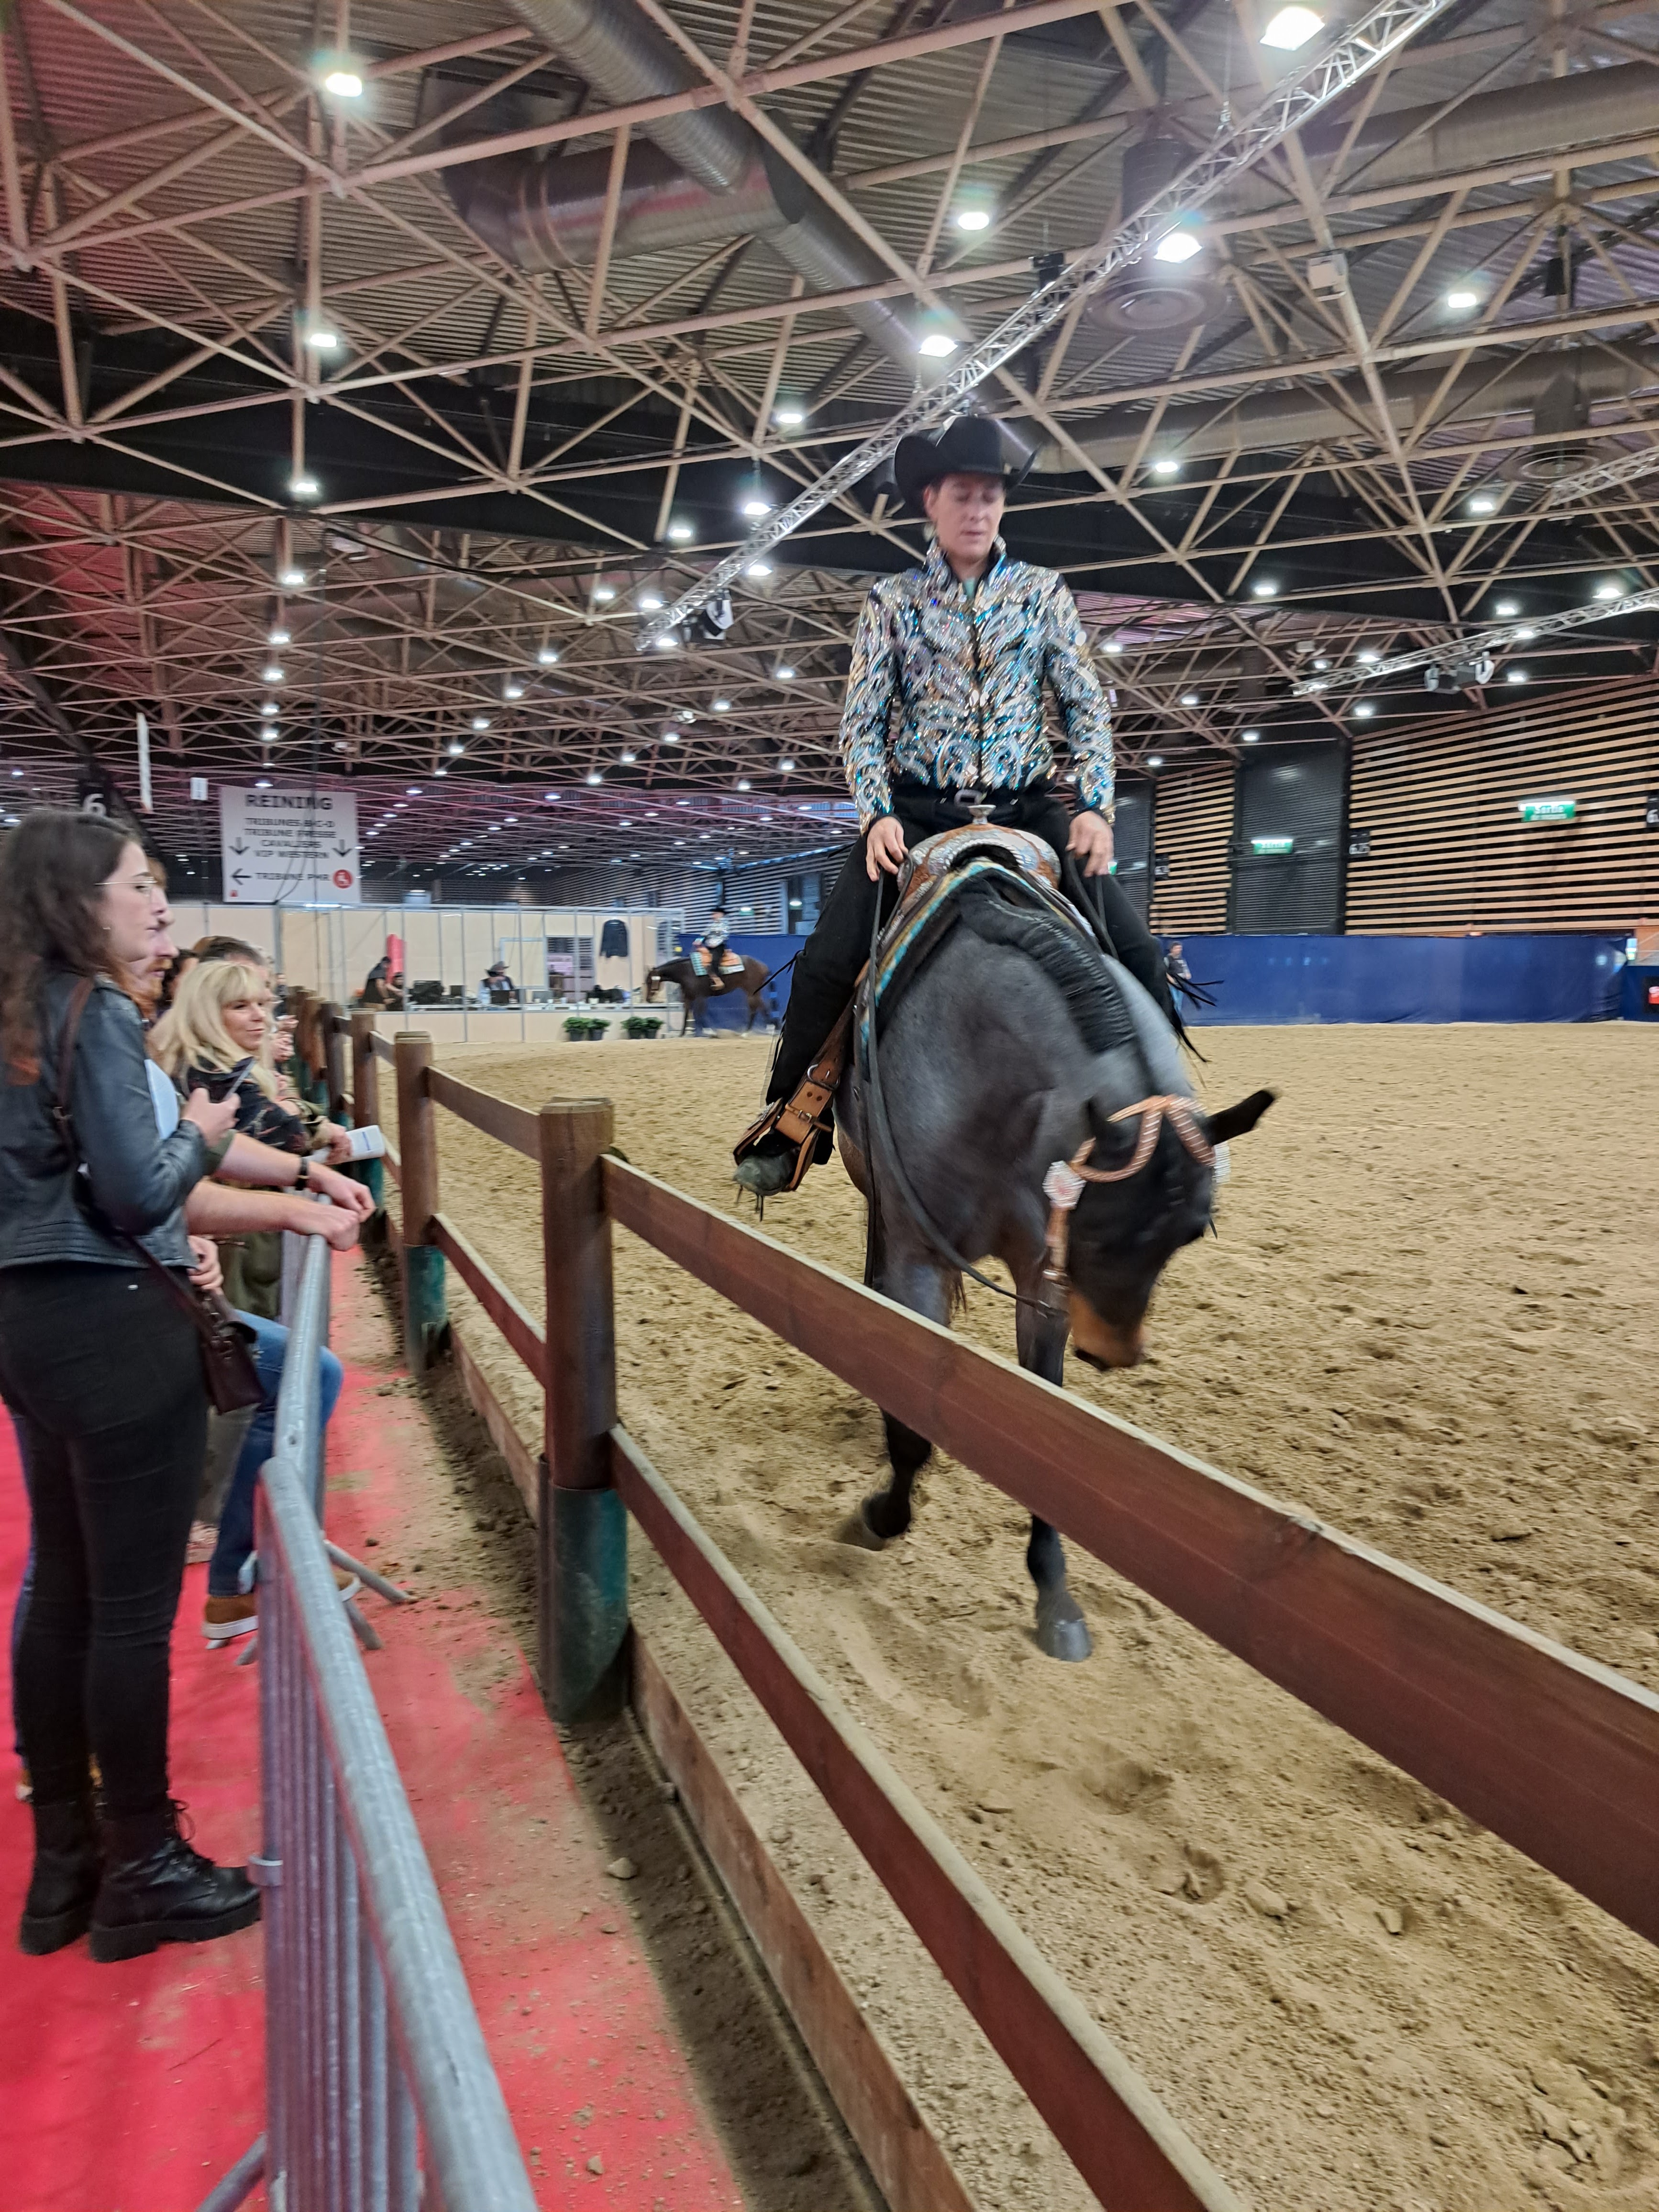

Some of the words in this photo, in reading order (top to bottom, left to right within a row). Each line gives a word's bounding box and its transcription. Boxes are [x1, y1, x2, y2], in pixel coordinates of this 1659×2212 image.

[245, 794, 333, 810] REINING
[244, 818, 300, 826] TRIBUNES
[244, 828, 293, 837] TRIBUNE
[277, 851, 330, 859] WESTERN
[255, 873, 303, 881] TRIBUNE
